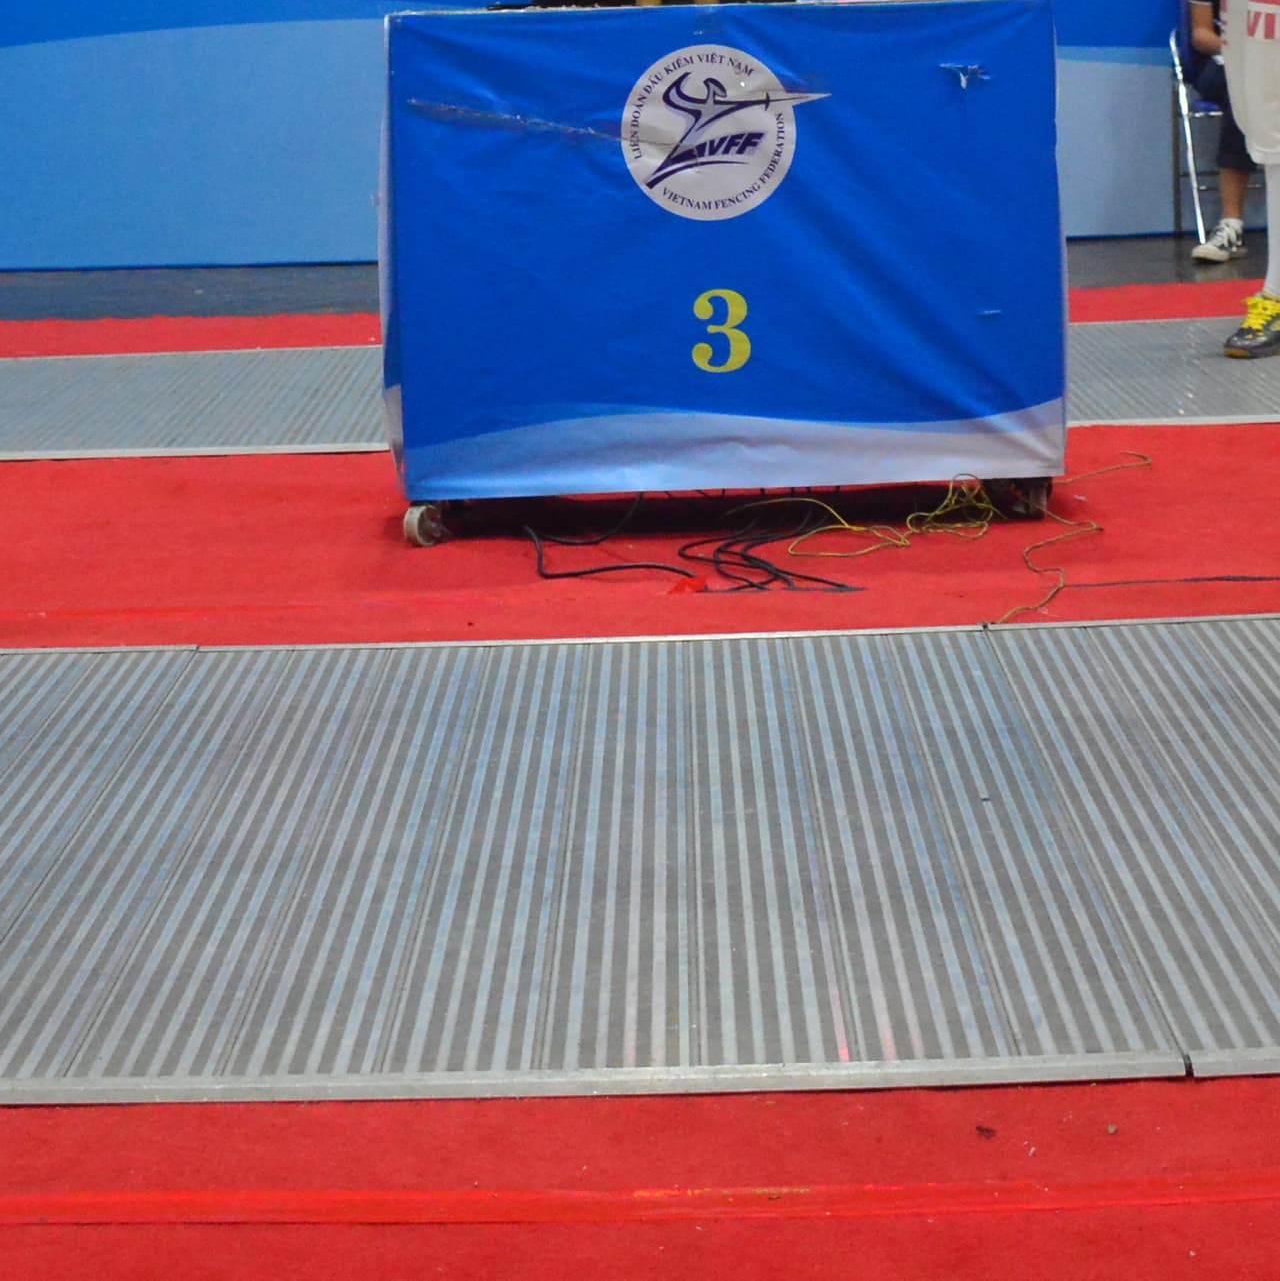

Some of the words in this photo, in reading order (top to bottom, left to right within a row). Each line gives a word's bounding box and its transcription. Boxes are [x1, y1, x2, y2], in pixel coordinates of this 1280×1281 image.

[727, 57, 754, 76] NAM
[662, 187, 711, 210] VIETNAM
[715, 182, 761, 209] FENCING
[758, 112, 785, 184] FEDERATION
[708, 132, 766, 156] VFF
[692, 288, 751, 373] 3
